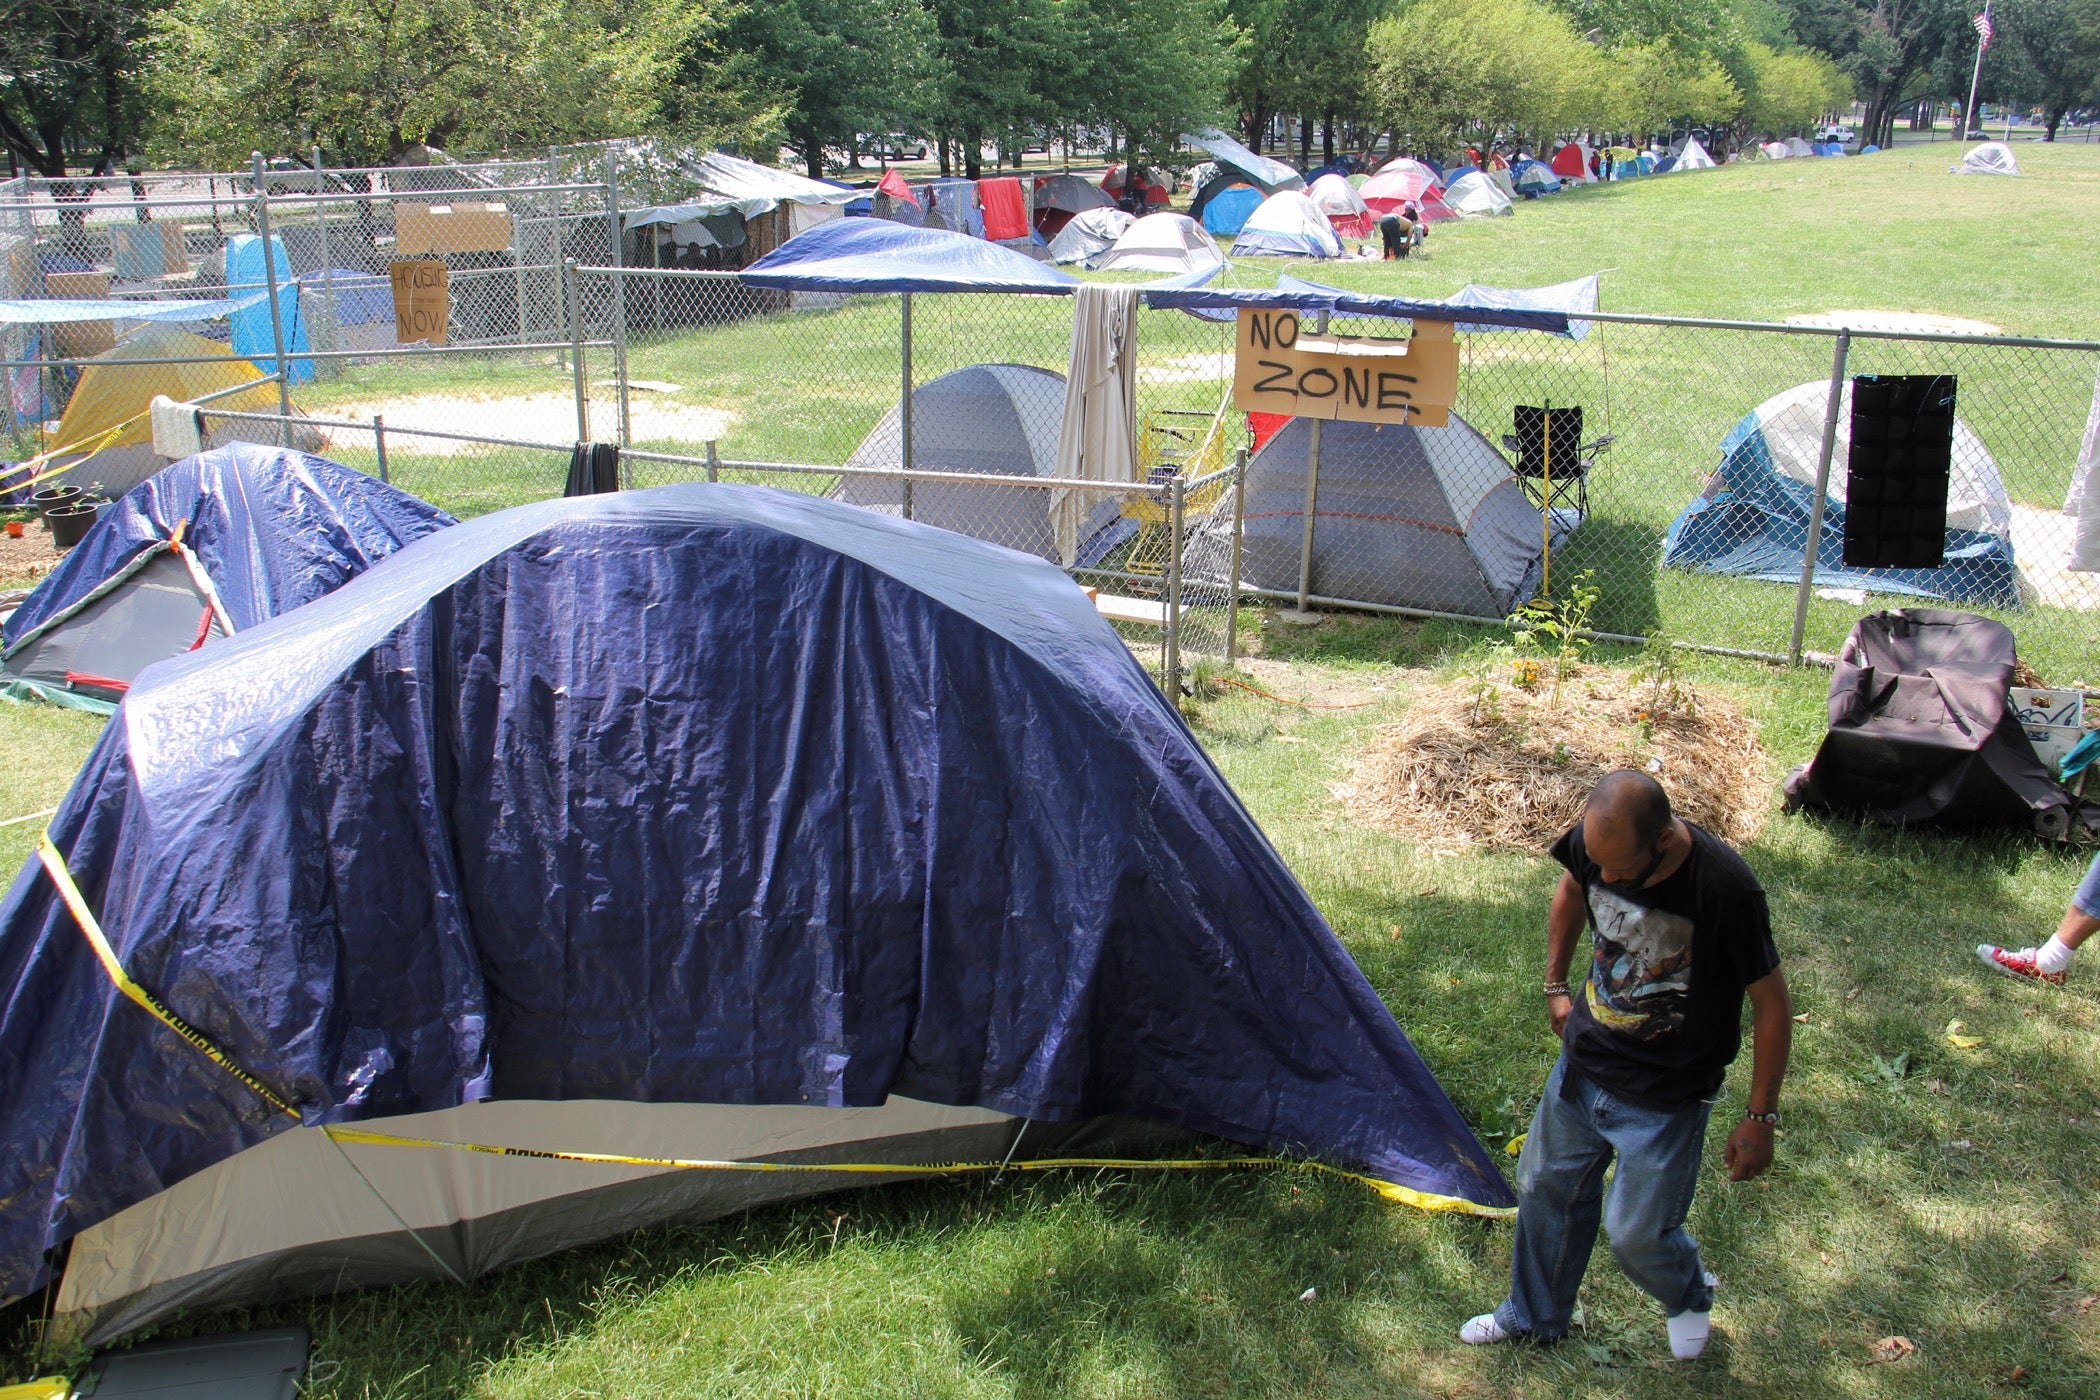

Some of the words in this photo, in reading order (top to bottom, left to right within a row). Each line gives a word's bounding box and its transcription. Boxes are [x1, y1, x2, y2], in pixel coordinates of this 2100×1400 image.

[392, 266, 448, 290] HOUSING
[399, 309, 446, 338] NOW
[1250, 313, 1299, 350] NO
[1252, 360, 1421, 415] ZONE
